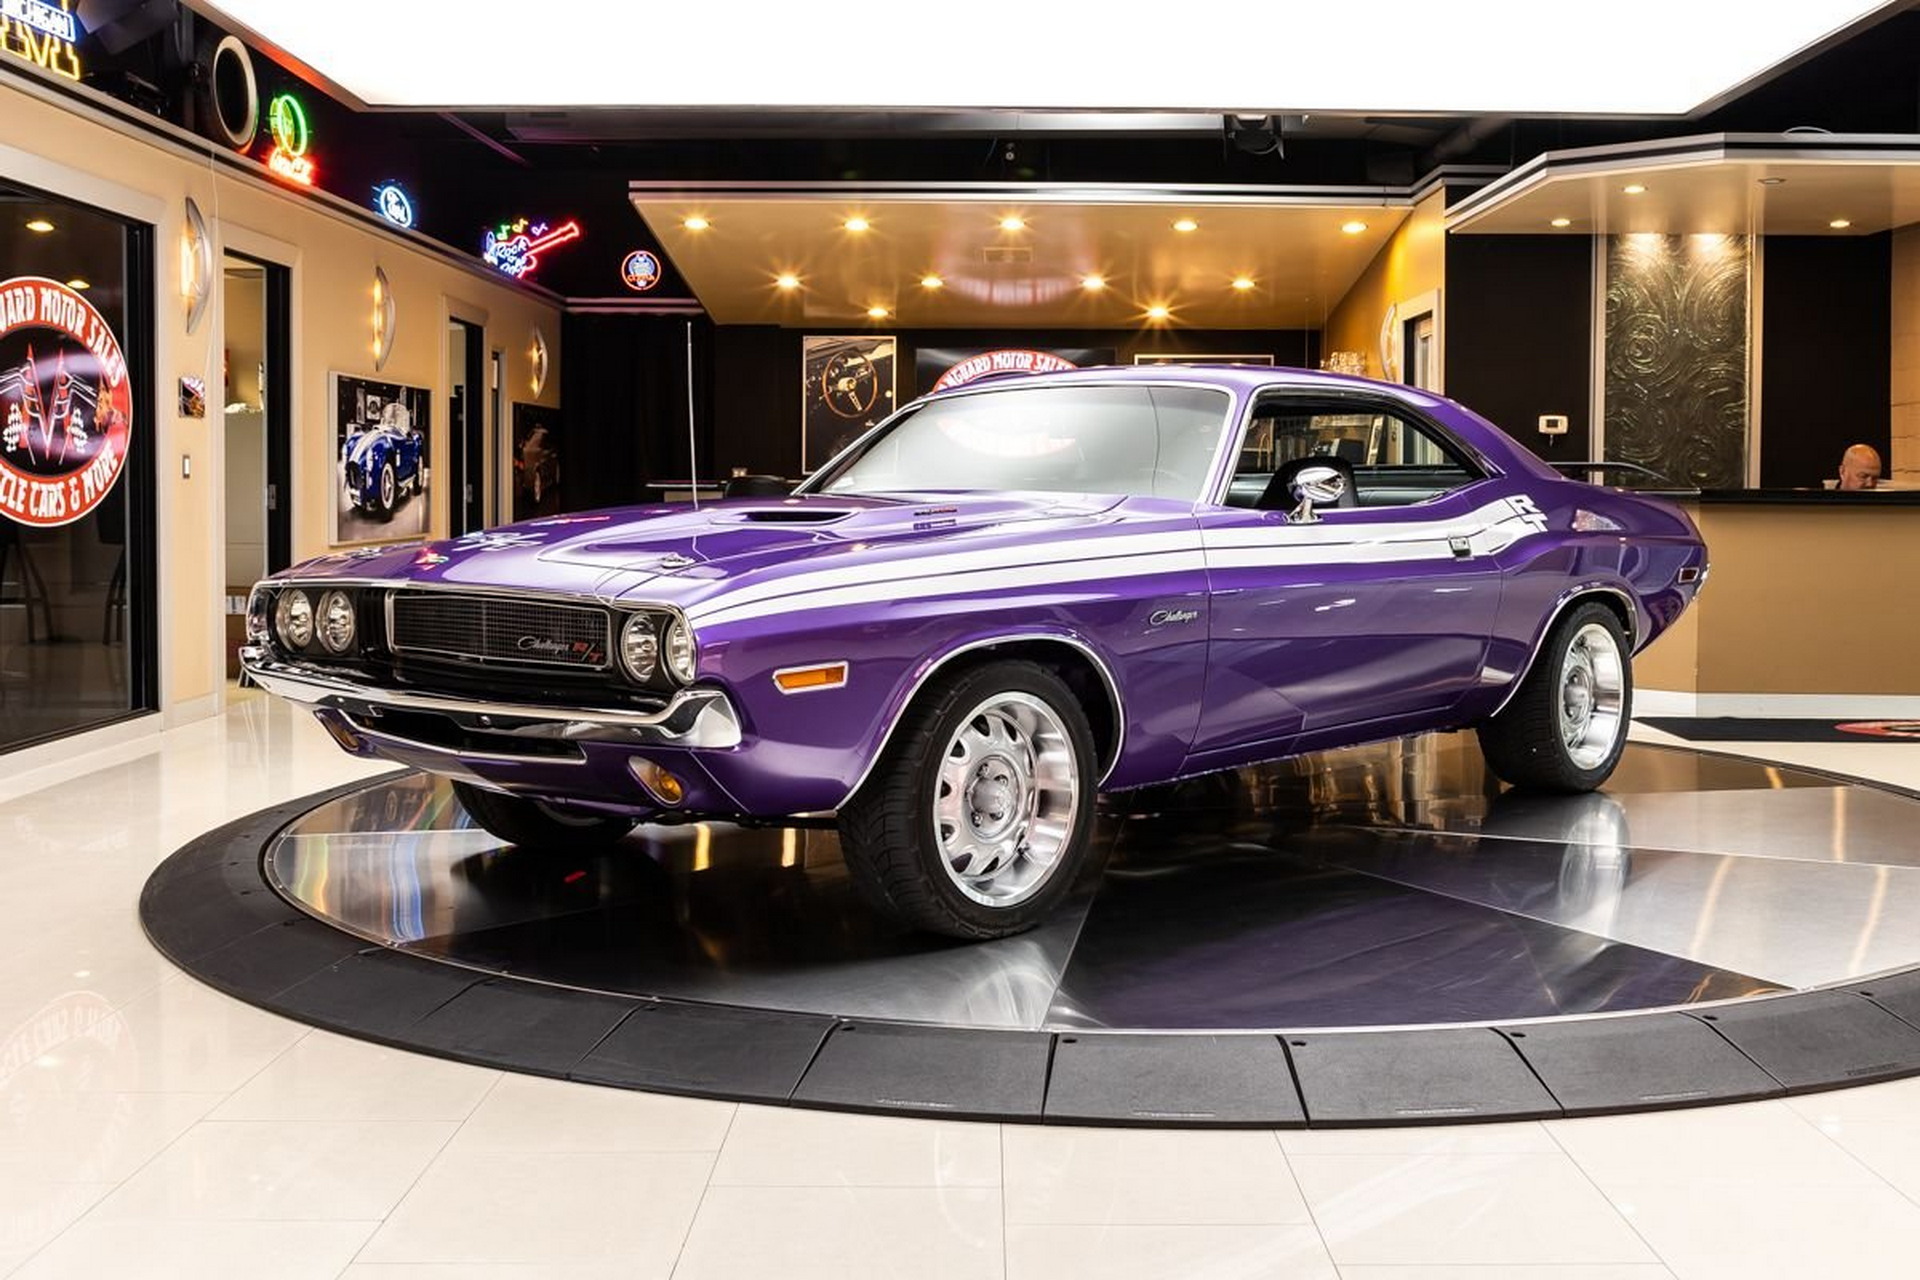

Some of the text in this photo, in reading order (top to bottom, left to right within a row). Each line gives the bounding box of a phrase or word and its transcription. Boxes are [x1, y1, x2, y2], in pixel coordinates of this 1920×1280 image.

[40, 287, 86, 339] MOTOR
[86, 315, 126, 387] SALES
[939, 355, 991, 389] NGUARD
[994, 351, 1032, 369] MOTOR
[0, 439, 118, 517] CLE CARS & MORE
